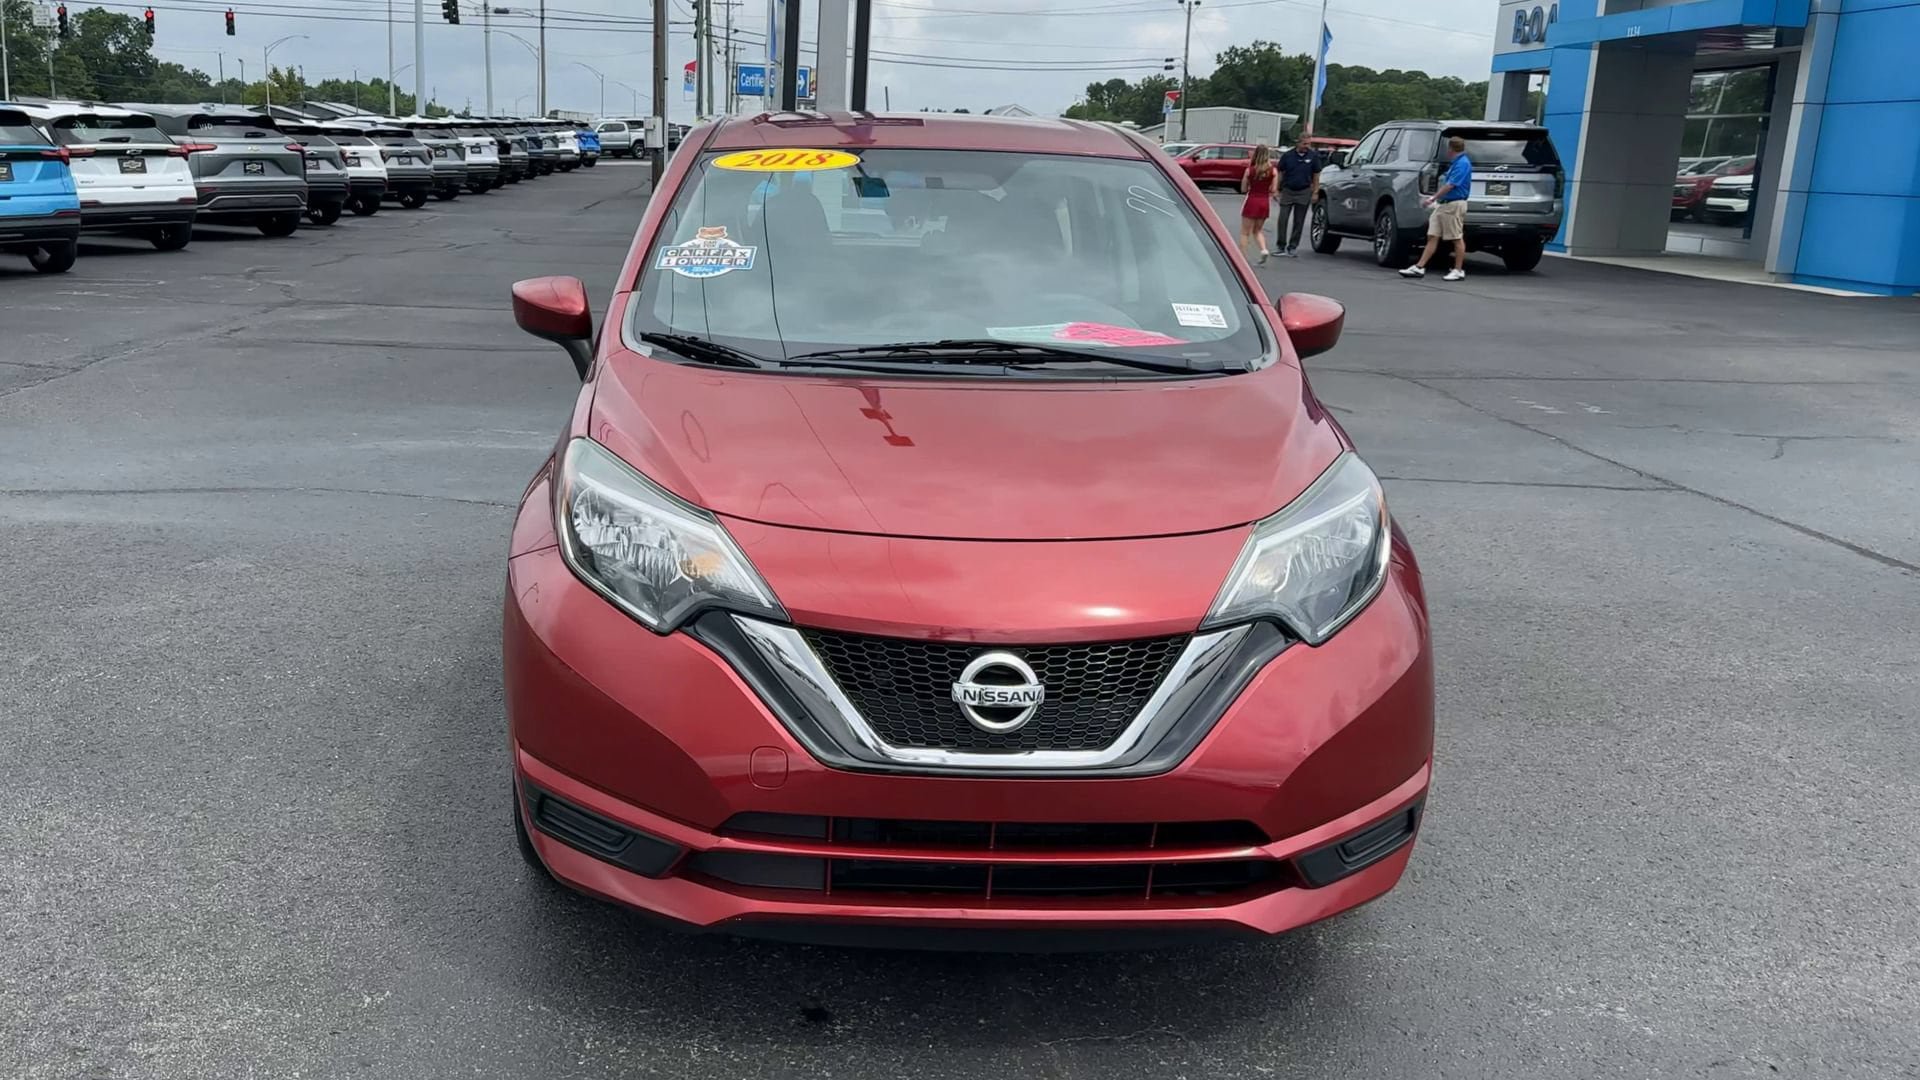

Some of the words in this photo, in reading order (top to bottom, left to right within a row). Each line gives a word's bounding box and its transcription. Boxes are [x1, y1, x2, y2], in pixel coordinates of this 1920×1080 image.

[1627, 26, 1641, 37] 1134
[740, 73, 765, 87] Certifie
[736, 152, 834, 167] 2018
[667, 249, 748, 257] CARFAX
[963, 689, 1034, 703] NISSAN
